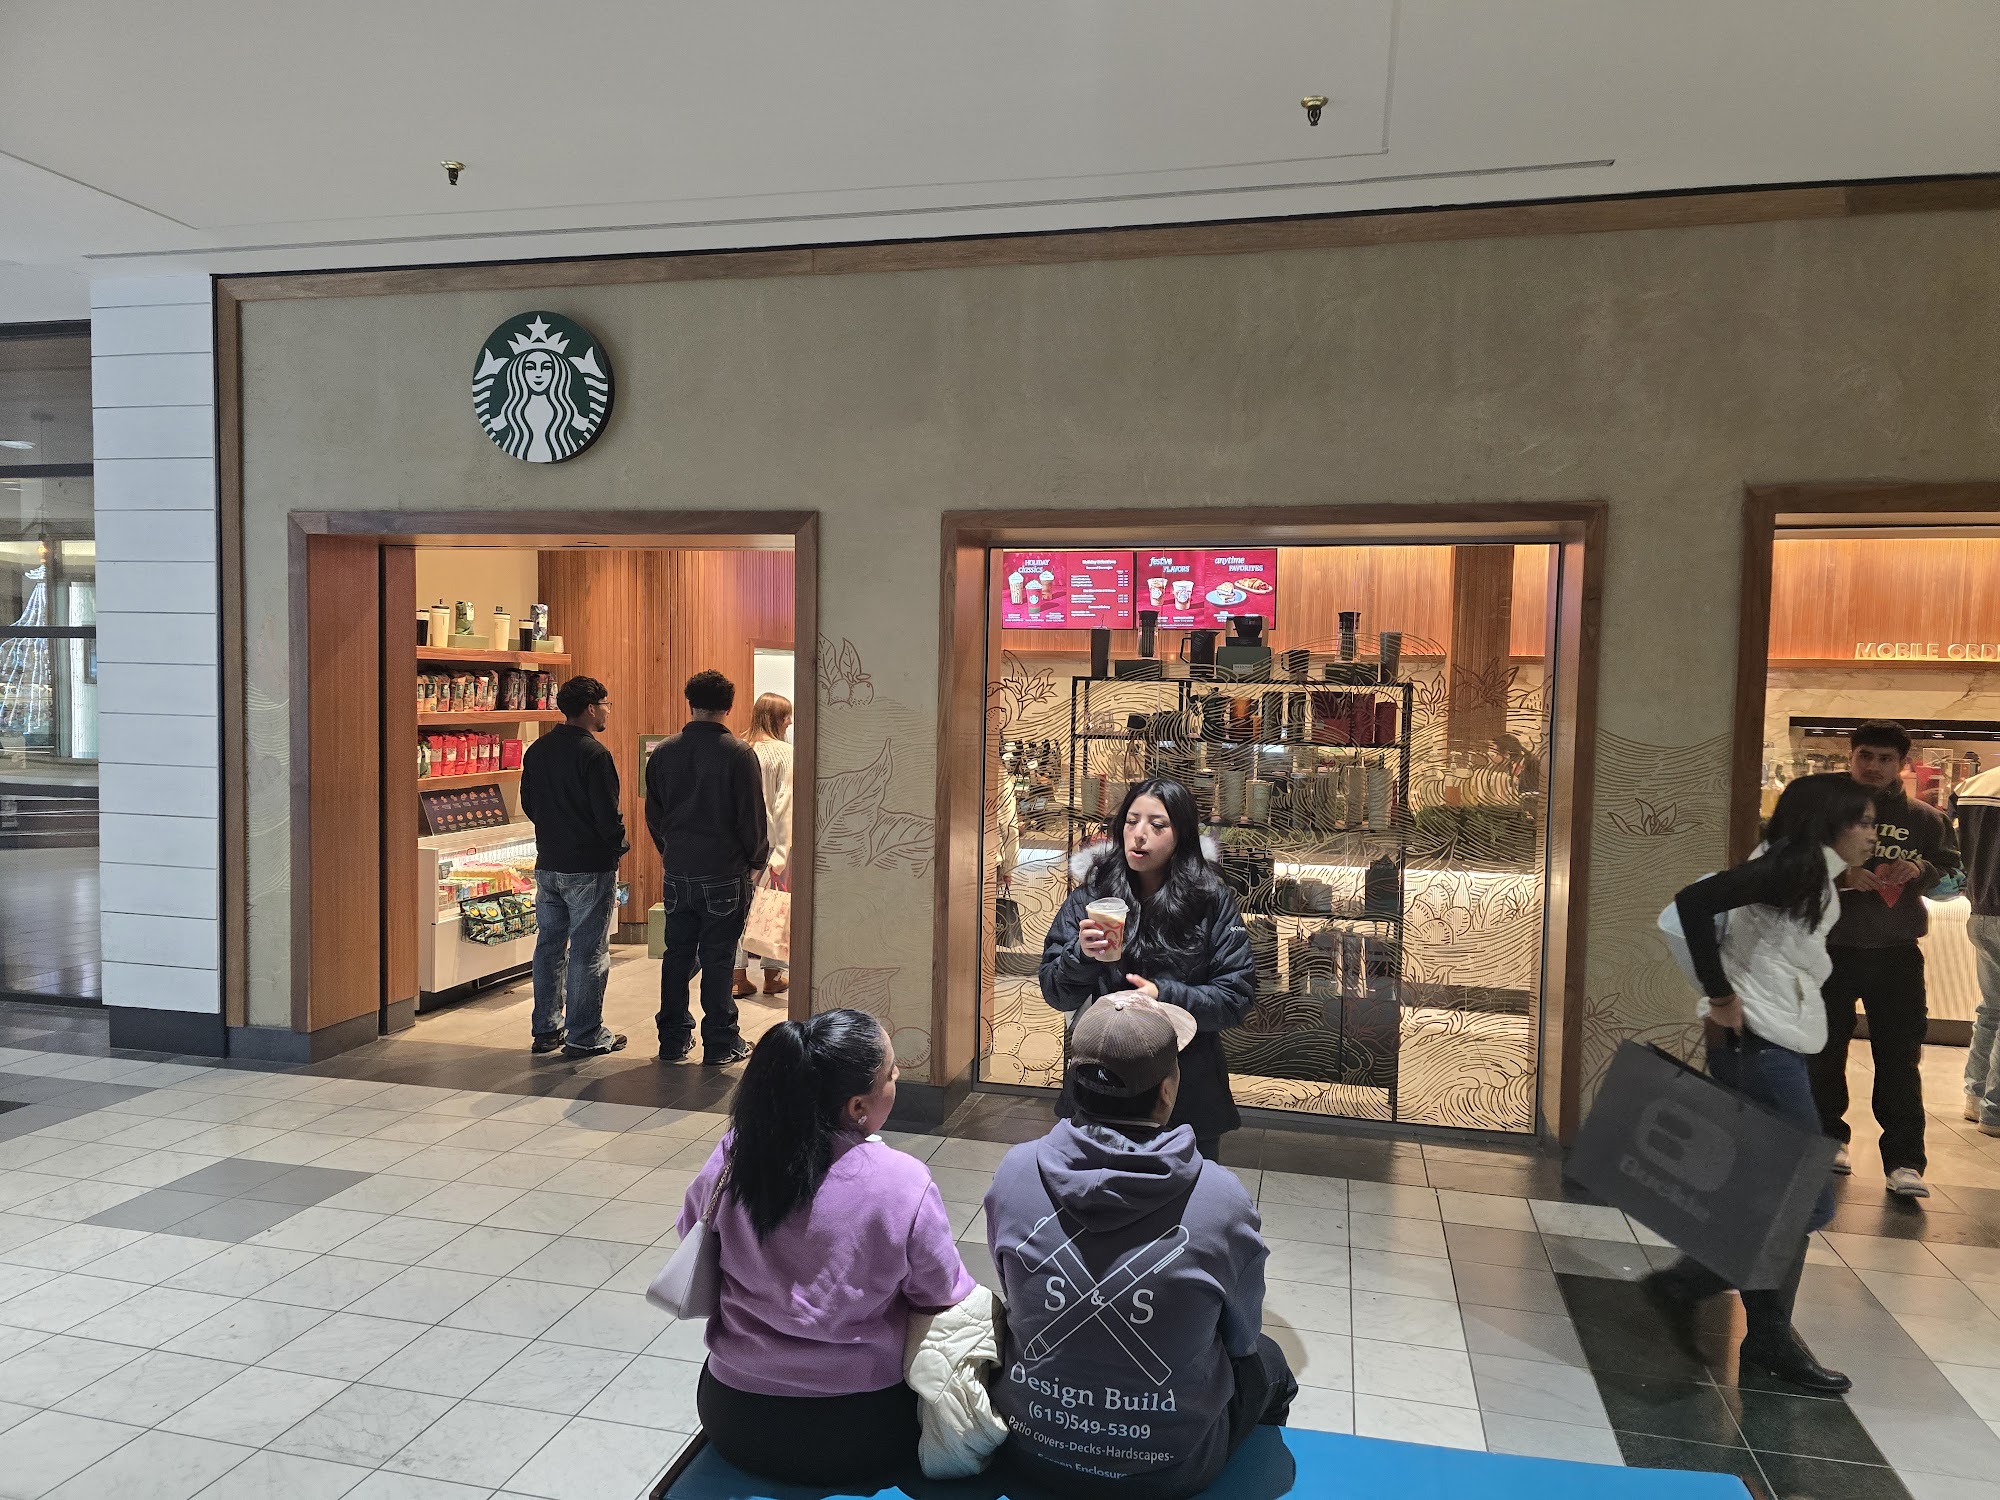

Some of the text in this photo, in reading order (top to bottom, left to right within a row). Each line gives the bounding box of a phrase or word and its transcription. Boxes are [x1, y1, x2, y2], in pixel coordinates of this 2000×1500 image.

[1149, 556, 1173, 567] festive
[1214, 555, 1245, 566] anytime
[1018, 565, 1044, 573] classics
[1163, 565, 1190, 573] FLAVORS
[1228, 564, 1264, 572] FAVORITES
[1854, 642, 2000, 660] MOBILE ORD
[1044, 1276, 1154, 1324] S & S
[1009, 1361, 1178, 1412] Design Build
[1028, 1400, 1151, 1440] (615)549-5309
[1008, 1415, 1032, 1436] Patio
[1033, 1431, 1175, 1464] covers-Decks-Hardscapes-
